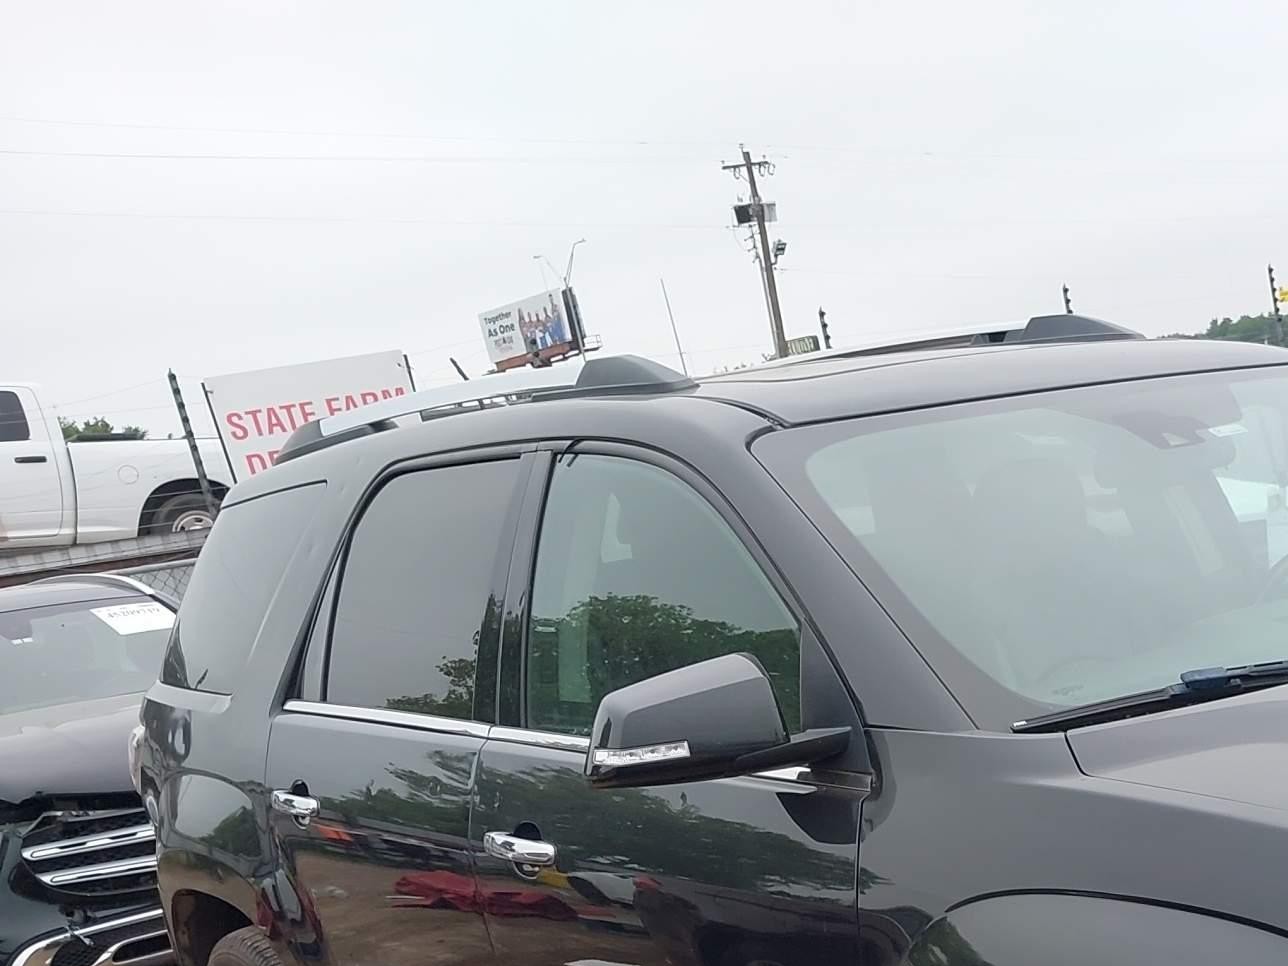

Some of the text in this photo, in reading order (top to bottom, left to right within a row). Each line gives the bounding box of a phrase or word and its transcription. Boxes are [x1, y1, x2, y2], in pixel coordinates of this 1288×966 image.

[484, 311, 512, 325] Together
[488, 323, 516, 338] As One
[226, 401, 313, 441] STATE
